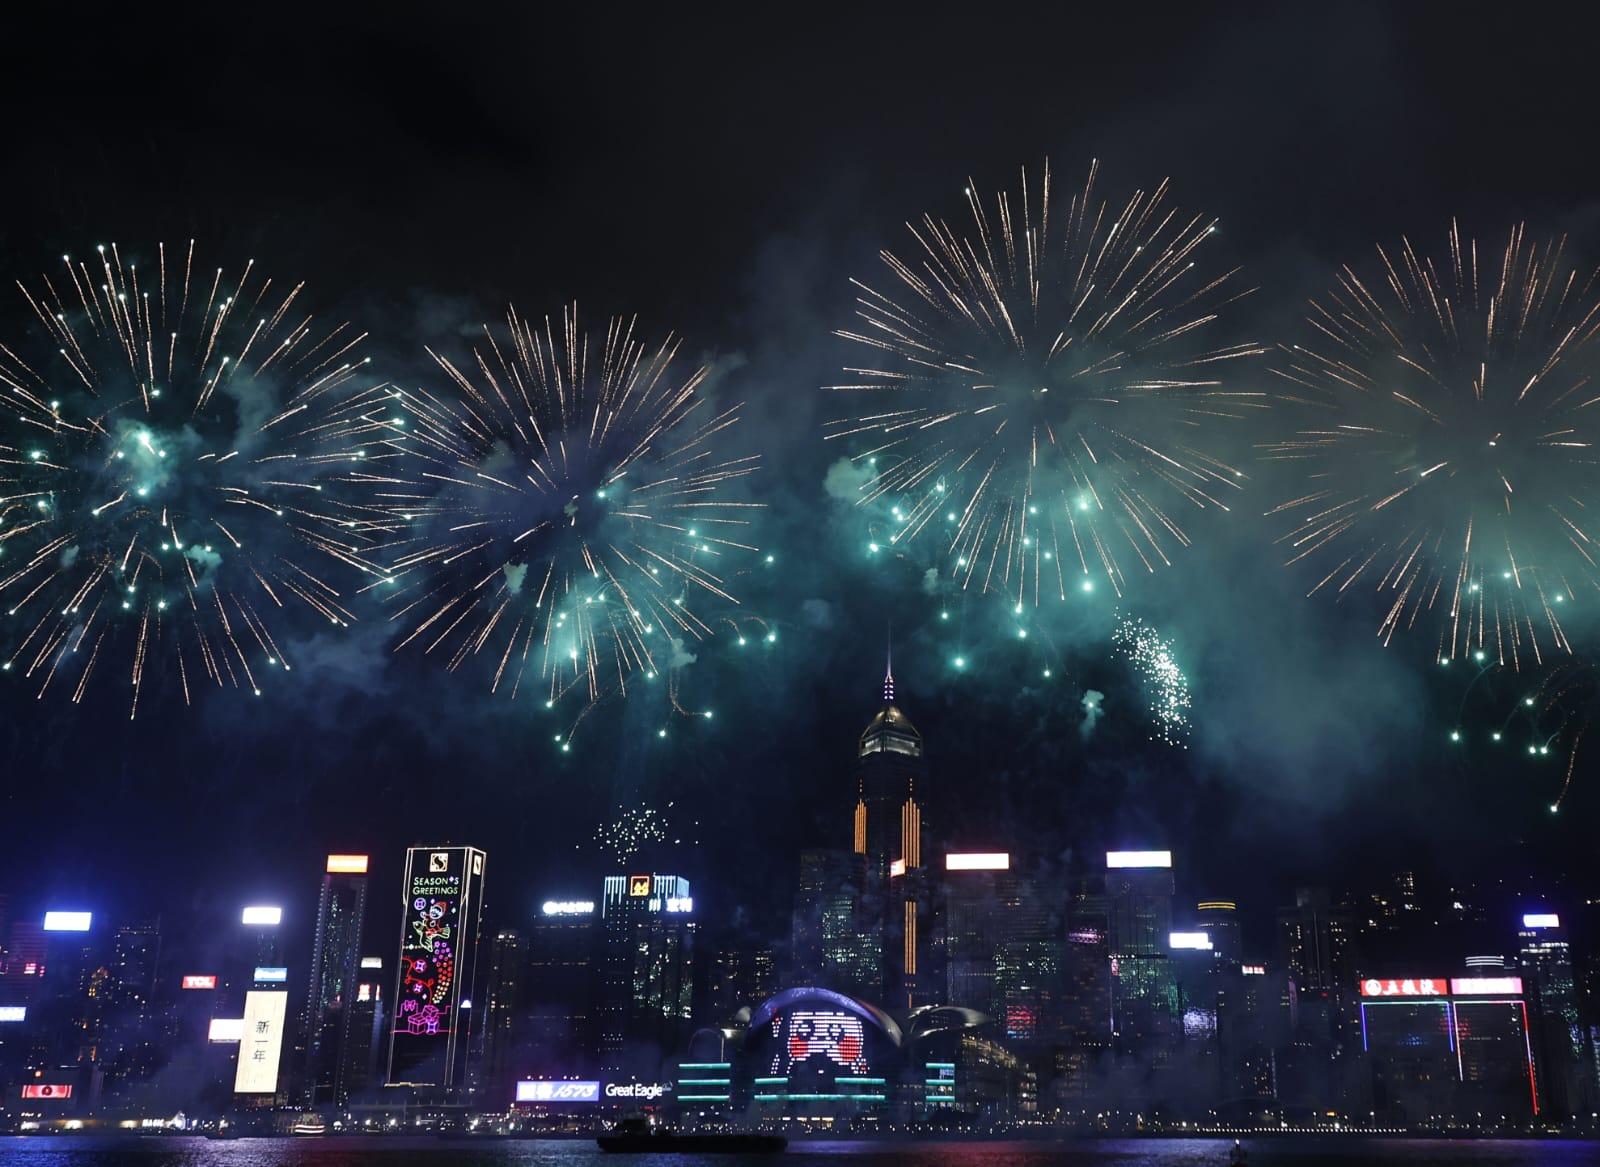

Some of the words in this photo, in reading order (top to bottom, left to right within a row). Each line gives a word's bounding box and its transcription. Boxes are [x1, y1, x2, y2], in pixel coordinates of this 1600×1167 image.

[412, 886, 458, 895] GREETINGS
[186, 976, 214, 987] TCL
[252, 1020, 271, 1063] 新一年
[605, 1083, 633, 1097] Great
[634, 1083, 663, 1100] Eagle
